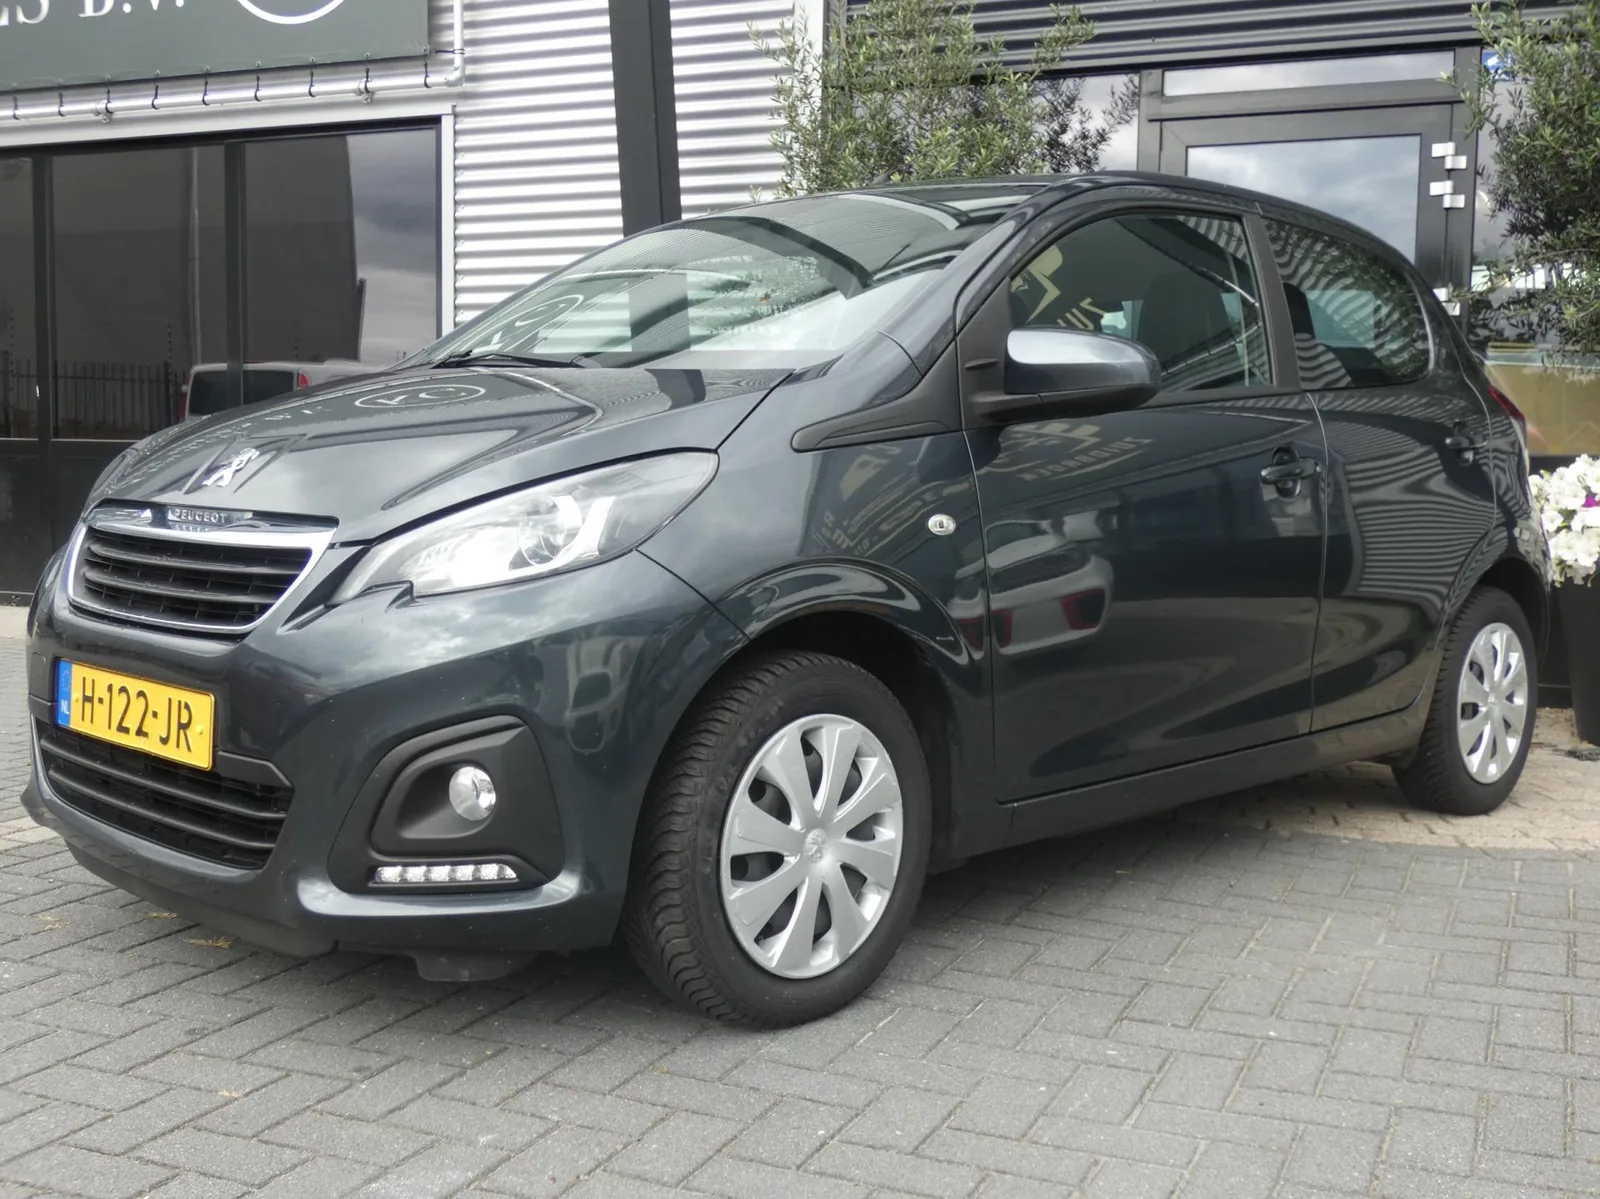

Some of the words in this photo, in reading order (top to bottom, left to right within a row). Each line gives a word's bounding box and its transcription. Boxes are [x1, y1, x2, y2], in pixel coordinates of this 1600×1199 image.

[174, 508, 227, 523] PEUGEOT
[60, 699, 70, 715] NL
[81, 676, 192, 752] H-122-JR
